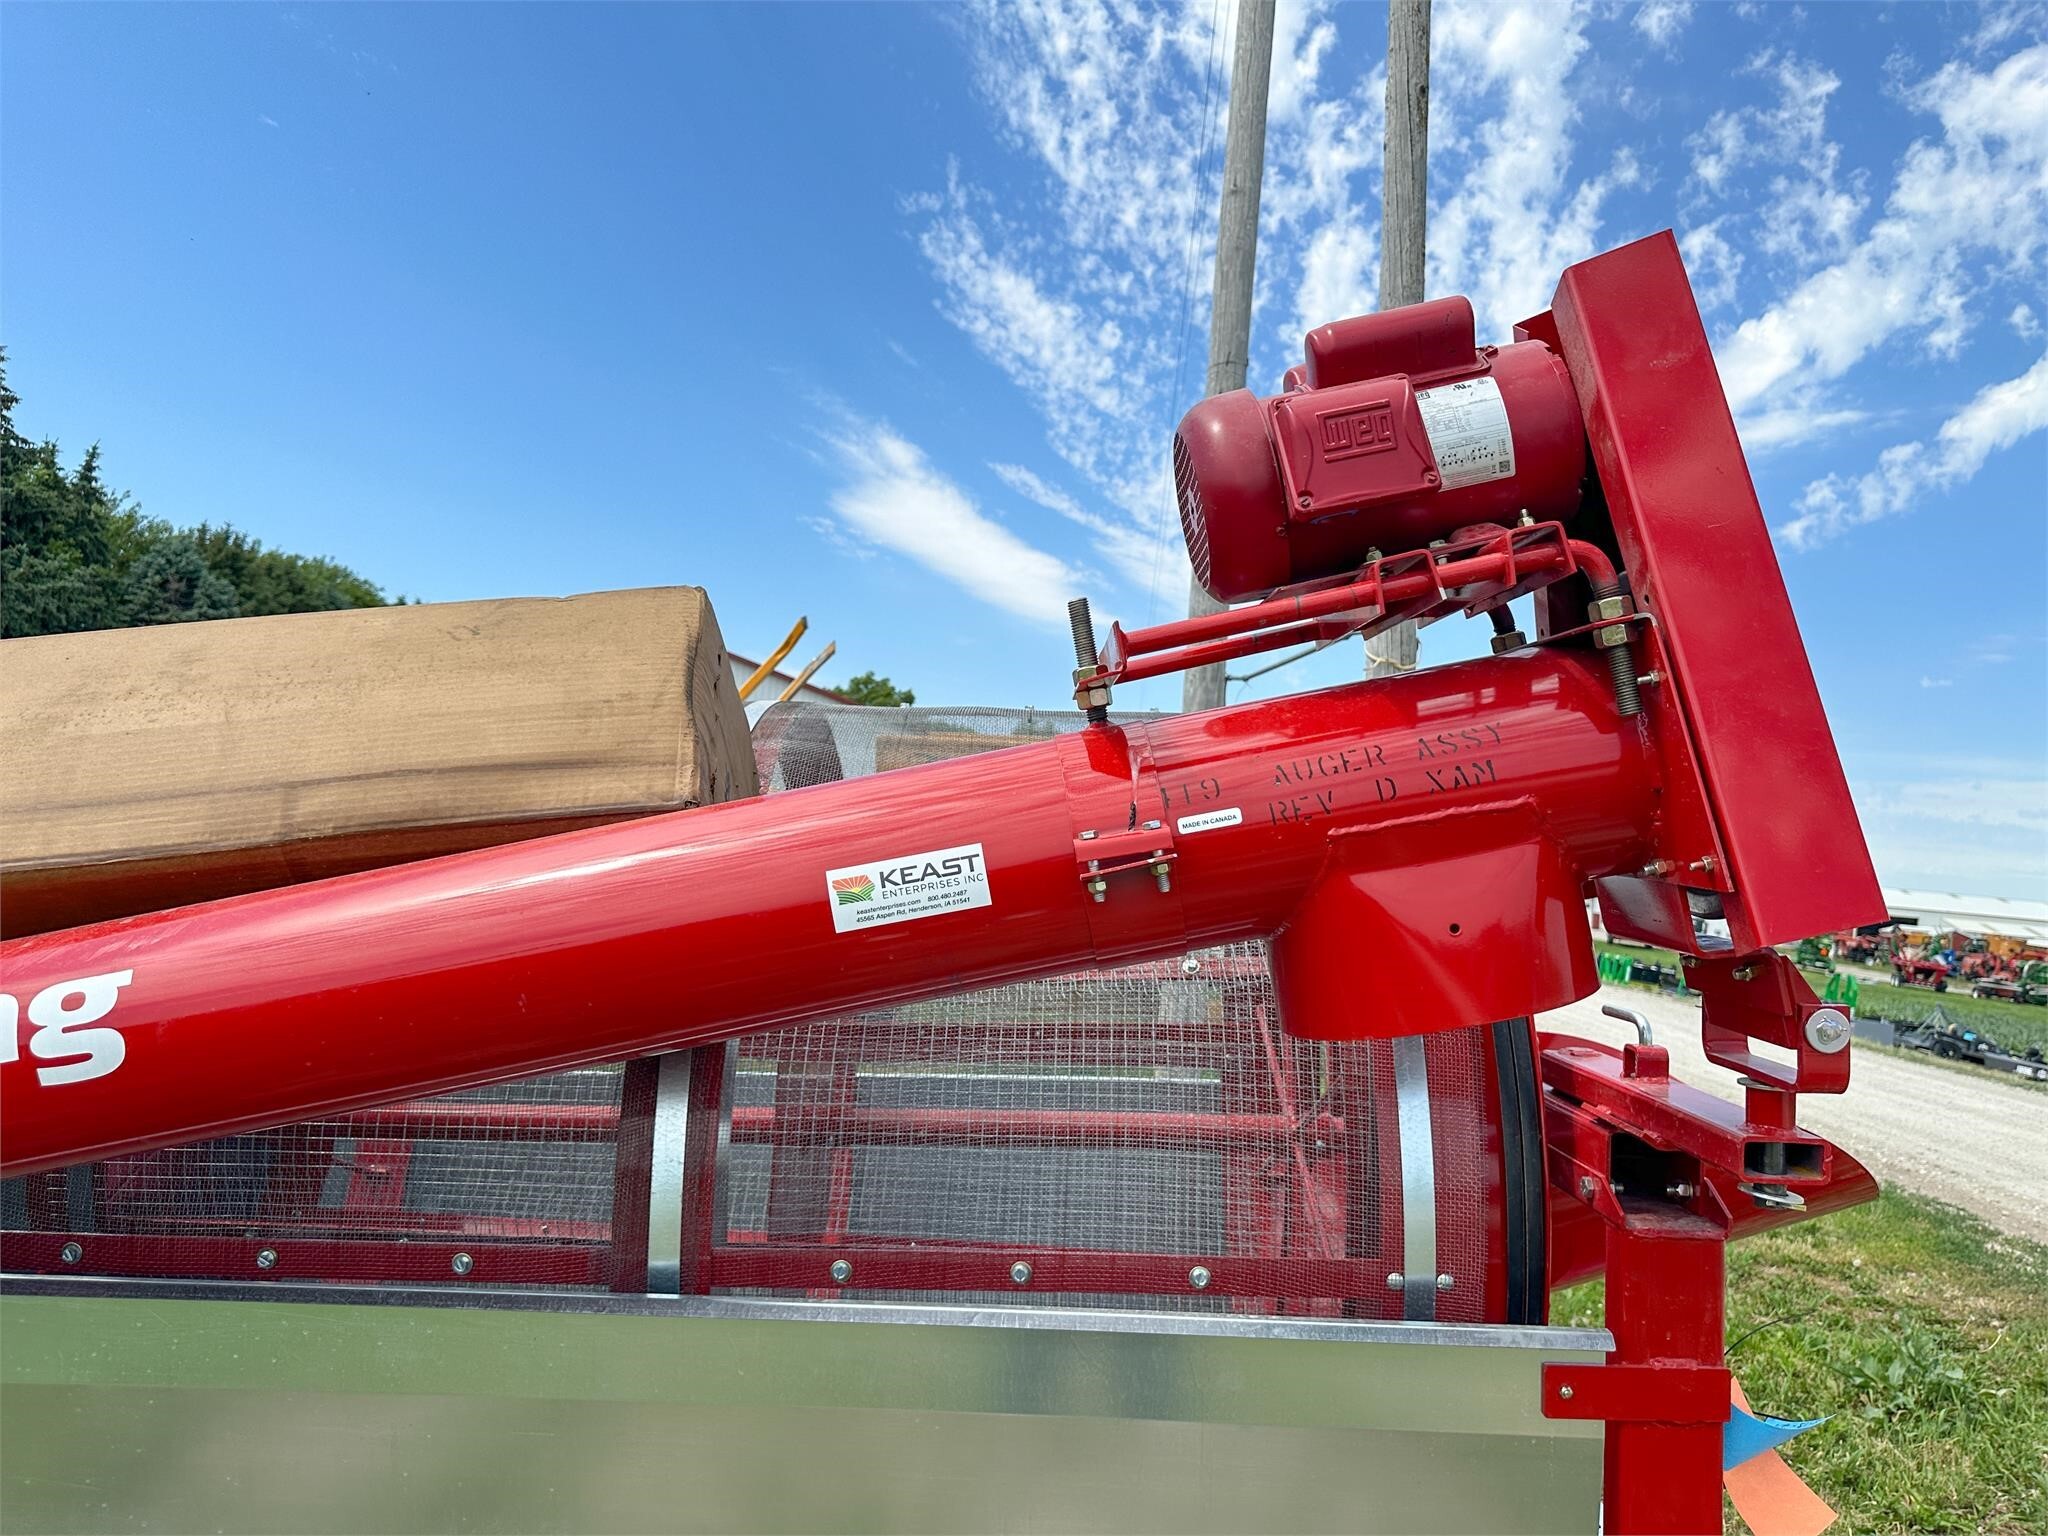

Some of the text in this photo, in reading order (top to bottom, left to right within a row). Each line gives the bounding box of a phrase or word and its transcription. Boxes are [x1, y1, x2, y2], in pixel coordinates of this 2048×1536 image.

[1274, 745, 1386, 784] AUGER
[1418, 722, 1500, 760] ASSY
[1269, 759, 1496, 826] REV D XAM
[1182, 820, 1201, 829] MADE
[1209, 814, 1237, 824] CANADA
[879, 853, 980, 889] KEAST
[882, 873, 985, 900] ENTERPRISES INC
[856, 889, 968, 915] keastenterprises.com 800.480.2487
[875, 911, 896, 921] Aspen
[898, 908, 908, 917] Rd,
[908, 903, 943, 914] Henderson,
[943, 899, 952, 907] IA
[952, 896, 971, 906] 51541
